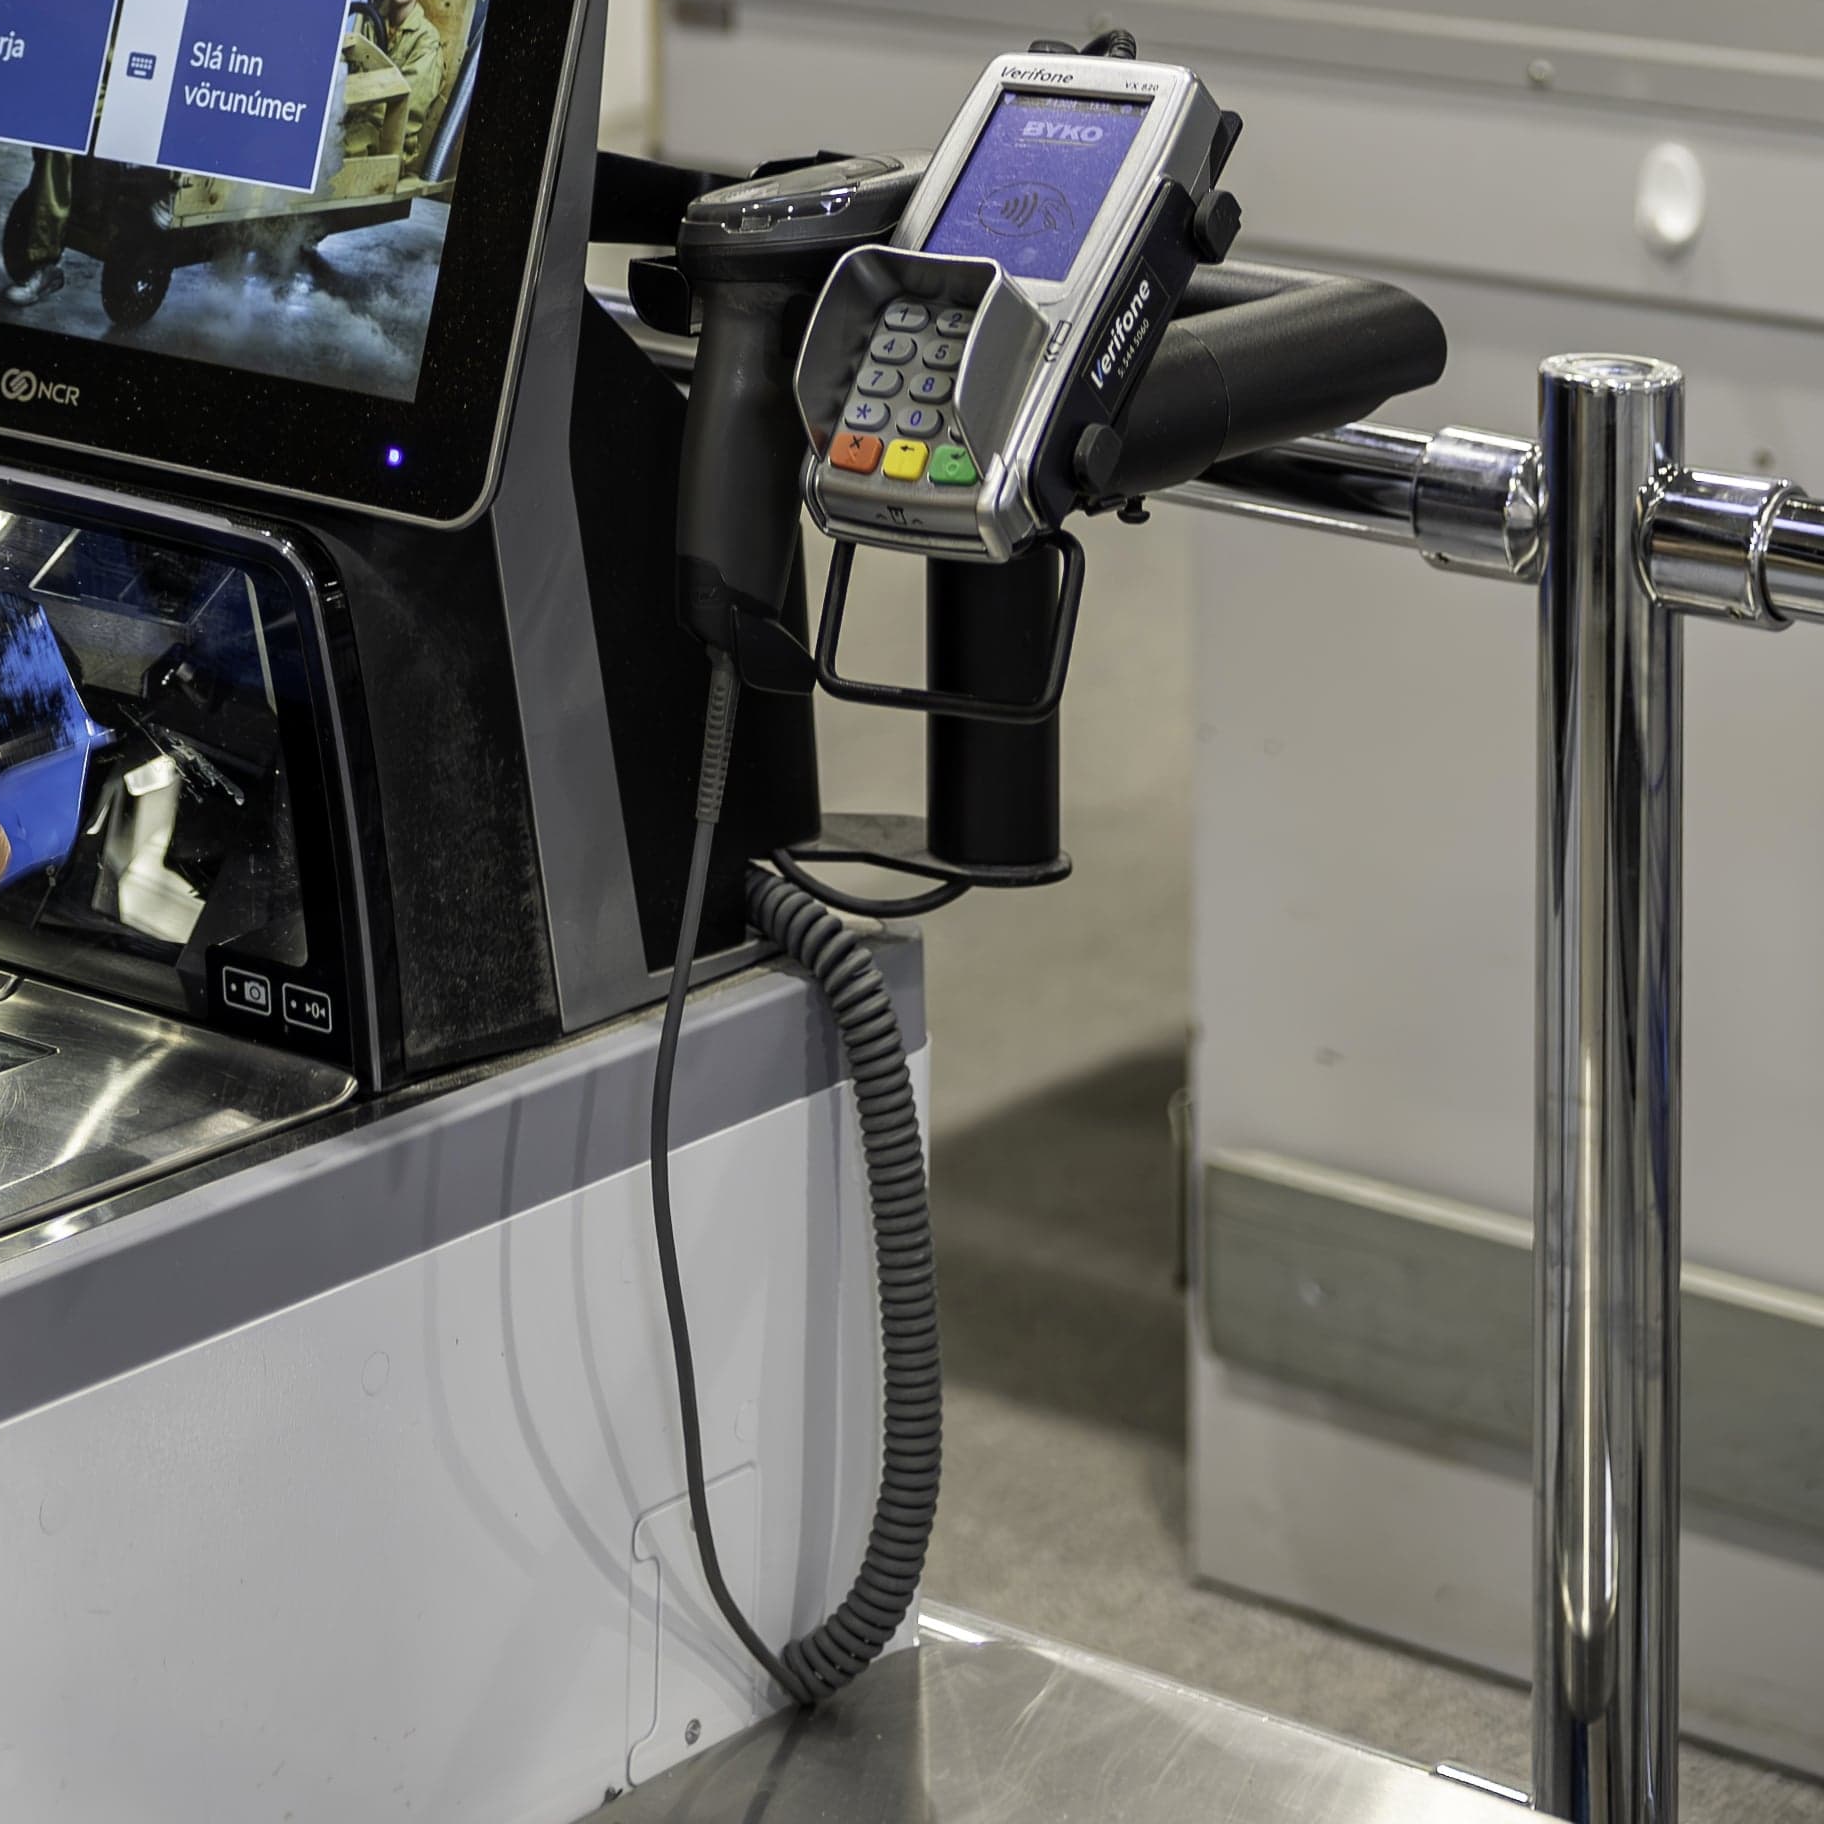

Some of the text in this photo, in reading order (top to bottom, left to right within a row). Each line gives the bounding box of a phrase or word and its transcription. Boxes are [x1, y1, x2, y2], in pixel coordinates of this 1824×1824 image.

[189, 40, 264, 78] Slá inn
[1000, 65, 1074, 84] Verifone
[183, 80, 308, 124] vörunúmer
[1022, 119, 1105, 143] BYKO
[1090, 278, 1151, 390] Verifone
[37, 380, 81, 407] NCR
